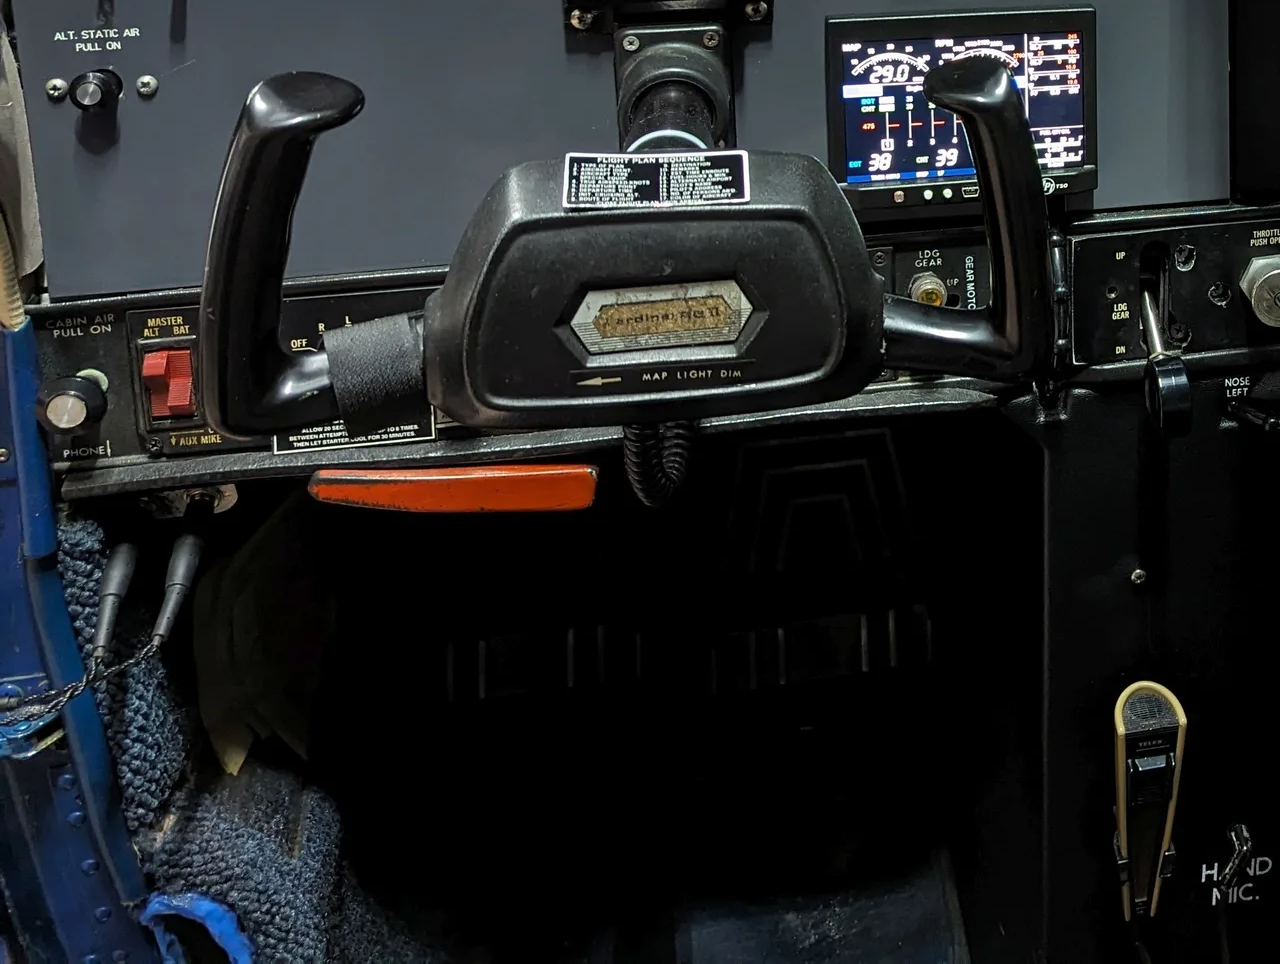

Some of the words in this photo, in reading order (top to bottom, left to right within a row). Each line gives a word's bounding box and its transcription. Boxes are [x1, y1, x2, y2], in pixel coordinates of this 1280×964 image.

[54, 31, 78, 40] ALT.
[81, 29, 118, 39] STATIC
[123, 28, 140, 36] AIR
[76, 43, 102, 51] PULL
[106, 42, 121, 50] ON
[869, 64, 910, 84] 29.0
[868, 153, 892, 171] 38
[935, 148, 959, 167] 39
[1250, 237, 1268, 246] PUSH
[918, 250, 940, 258] LDG
[1116, 252, 1126, 260] UP
[915, 258, 942, 268] GEAR
[1114, 303, 1128, 312] LDG
[1112, 311, 1129, 320] GEAR
[45, 317, 87, 329] CABIN
[94, 314, 114, 323] AIR
[148, 316, 183, 326] MASTER
[53, 327, 84, 338] PULL
[90, 324, 112, 334] ON
[144, 328, 159, 337] ALT
[173, 325, 190, 335] BAT
[291, 339, 307, 348] OFF
[1116, 346, 1126, 354] DN
[642, 372, 667, 381] MAP
[677, 370, 712, 379] LIGHT
[720, 369, 741, 378] DIM
[1224, 377, 1250, 387] NOSE
[1227, 388, 1248, 398] LEFT
[179, 437, 198, 446] AUX
[200, 435, 222, 444] MIKE
[63, 446, 105, 458] PHONE
[1138, 740, 1162, 748] TELEX
